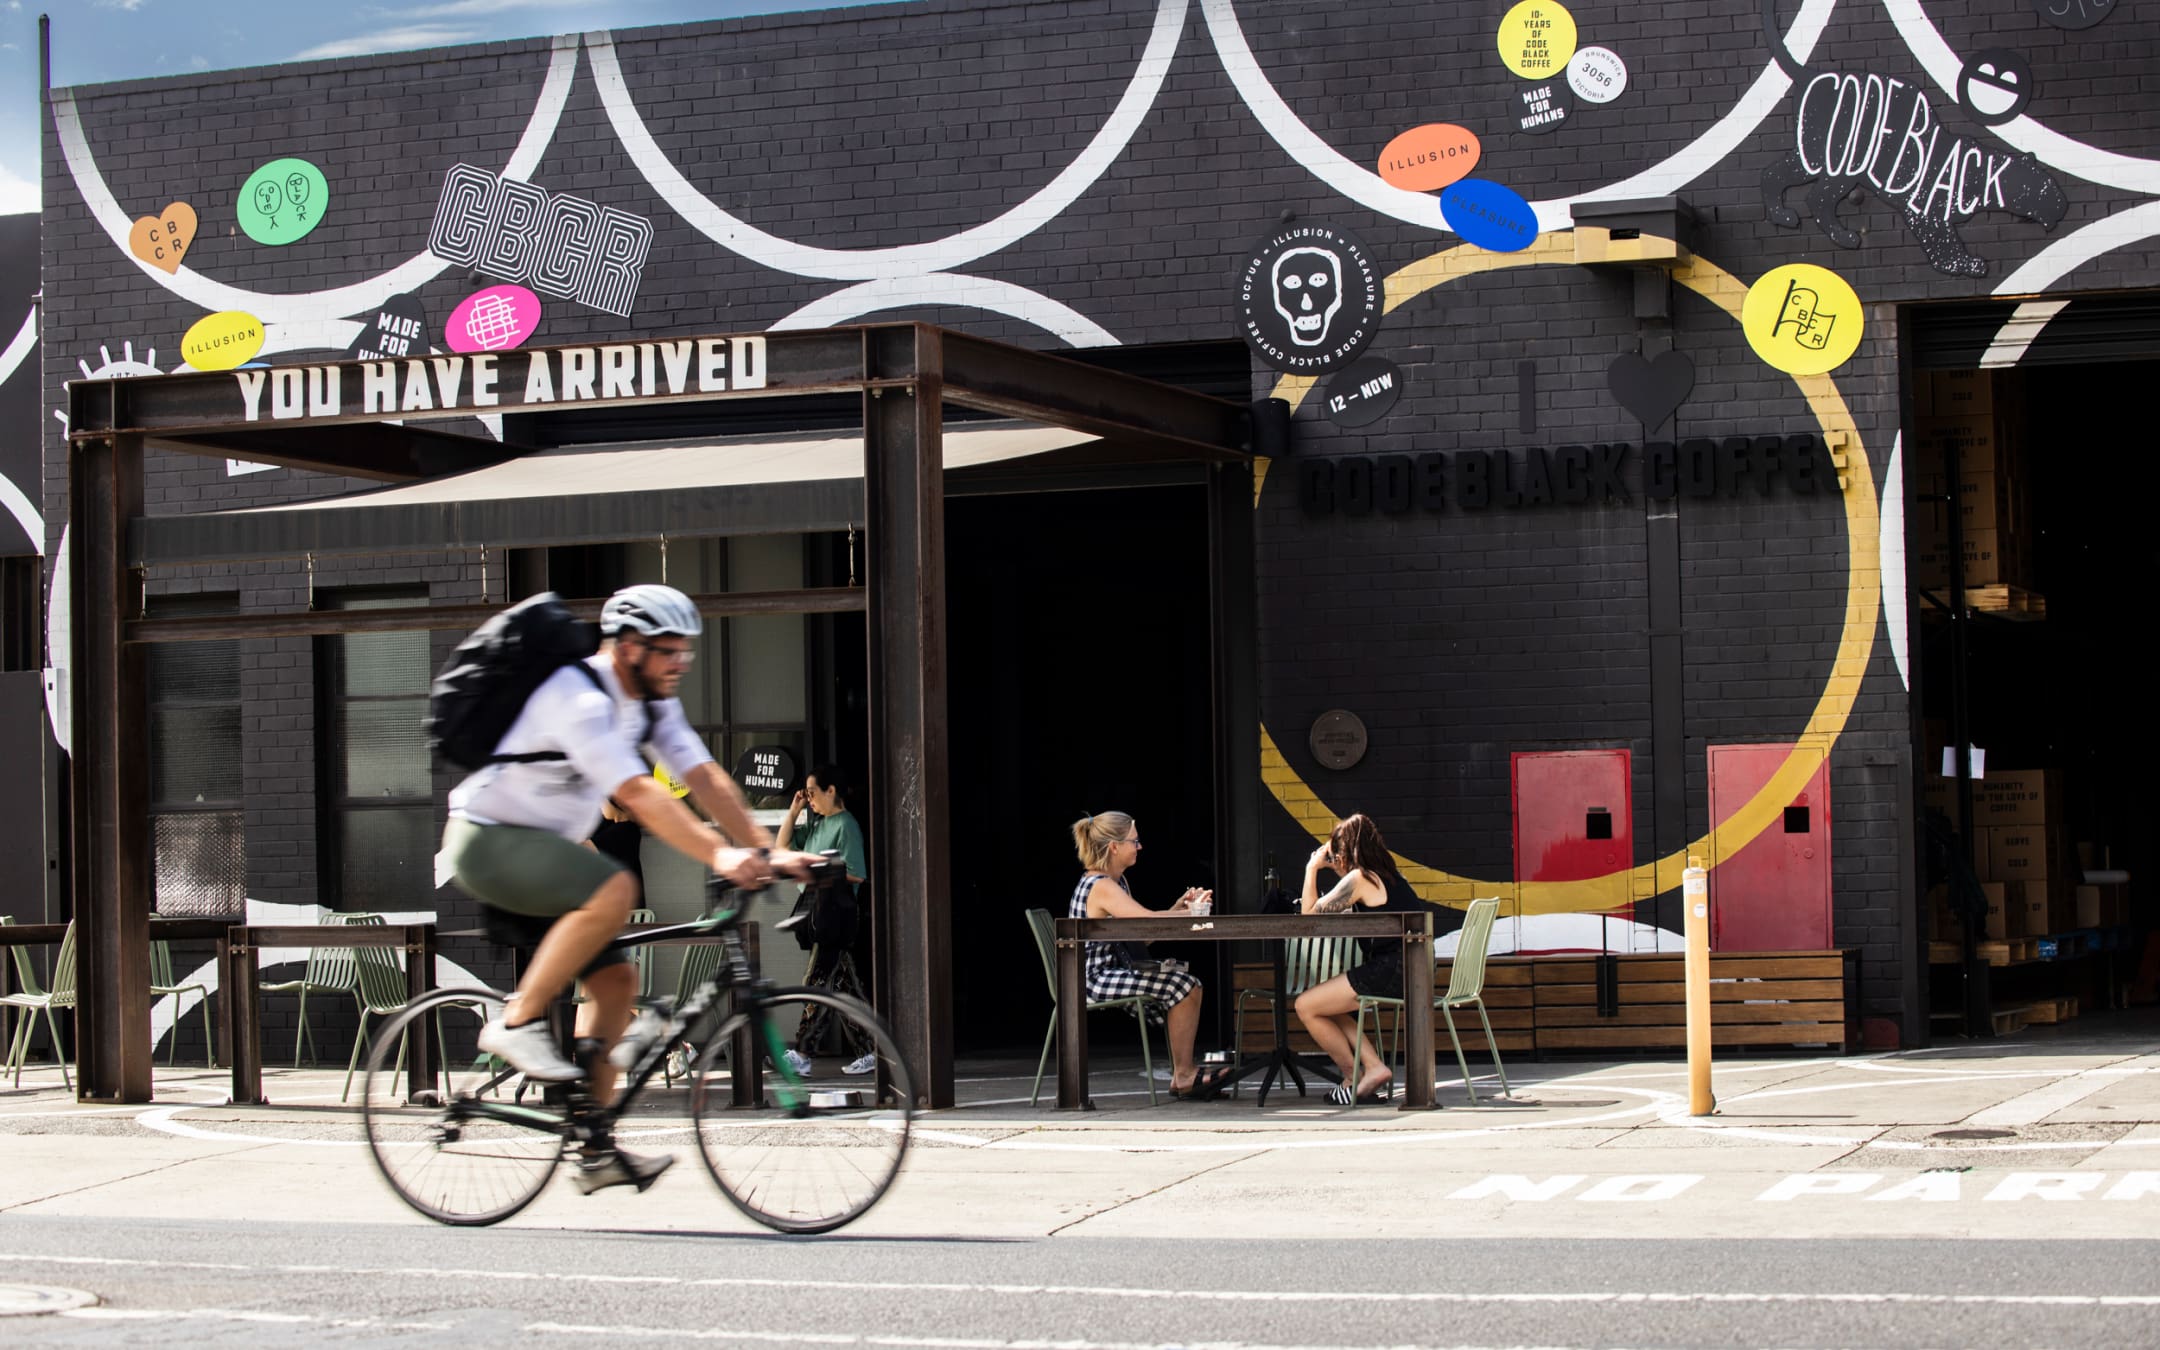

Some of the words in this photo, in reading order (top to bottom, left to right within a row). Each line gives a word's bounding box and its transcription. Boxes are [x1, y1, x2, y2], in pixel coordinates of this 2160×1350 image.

[1524, 20, 1551, 28] YEARS
[1531, 30, 1542, 38] OF
[1523, 50, 1549, 58] BLACK
[1526, 40, 1547, 48] CODE
[1521, 60, 1551, 68] COFFEE
[1581, 62, 1613, 87] 3056
[1585, 50, 1622, 77] BRUNSWICK
[1522, 86, 1552, 104] MADE
[1574, 77, 1606, 99] VICTORIA
[1521, 108, 1565, 129] HUMANS
[1530, 99, 1550, 114] FOR
[1389, 143, 1469, 171] ILLUSION
[1451, 194, 1528, 236] PLEASURE
[427, 162, 654, 318] CBCR
[1273, 228, 1332, 247] ILLUSION
[1242, 258, 1262, 301] OCFUG
[1349, 245, 1375, 311] PLEASURE
[377, 312, 421, 339] MADE
[191, 329, 256, 354] ILLUSION
[379, 333, 410, 358] FOR
[1247, 320, 1284, 360] COFFEE
[1335, 329, 1363, 358] CODE
[1289, 354, 1331, 366] BLACK
[235, 365, 341, 422] YOU
[359, 354, 499, 414] HAVE
[524, 335, 767, 404] ARRIVED
[1329, 394, 1347, 413] 12
[1360, 372, 1393, 399] NOW
[1302, 453, 1445, 514] CODE
[1457, 444, 1630, 508] BLACK
[1645, 433, 1849, 500] COFFEE
[754, 753, 779, 766] MADE
[757, 765, 774, 777] FOR
[745, 775, 784, 789] HUMANS
[1443, 1174, 1706, 1201] NO
